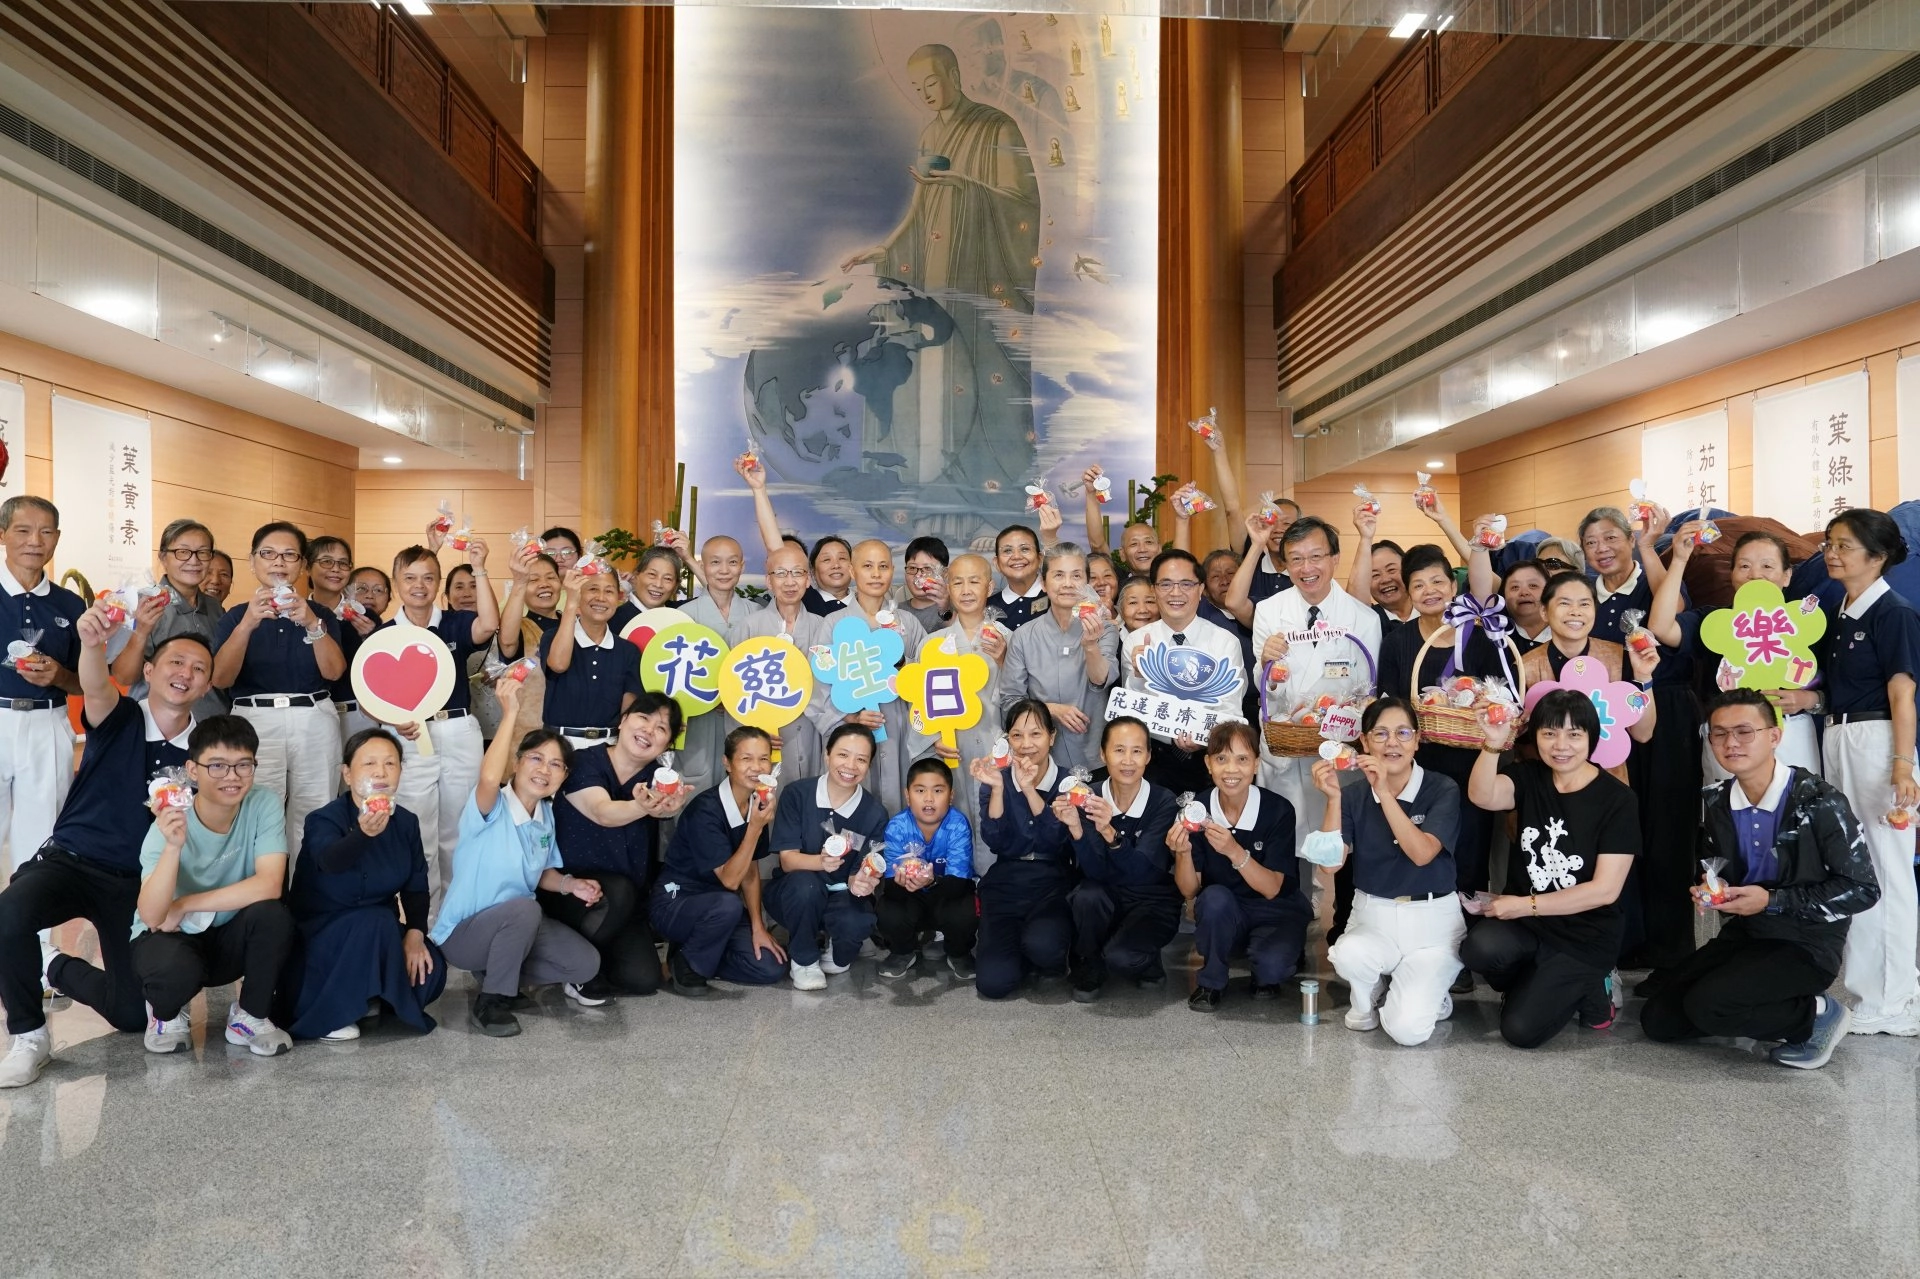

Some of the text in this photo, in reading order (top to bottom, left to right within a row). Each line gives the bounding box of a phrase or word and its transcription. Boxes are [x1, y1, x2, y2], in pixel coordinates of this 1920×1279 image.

[120, 444, 139, 546] 葉黃素
[1699, 442, 1717, 507] 茄紅
[1287, 627, 1343, 642] thank you
[1733, 608, 1795, 664] 樂
[657, 635, 720, 702] 花
[733, 648, 803, 714] 慈
[839, 641, 888, 698] 生
[926, 668, 965, 719] 日
[1151, 721, 1170, 734] Tzu
[1174, 727, 1193, 738] Ch
[1329, 714, 1357, 729] Happy
